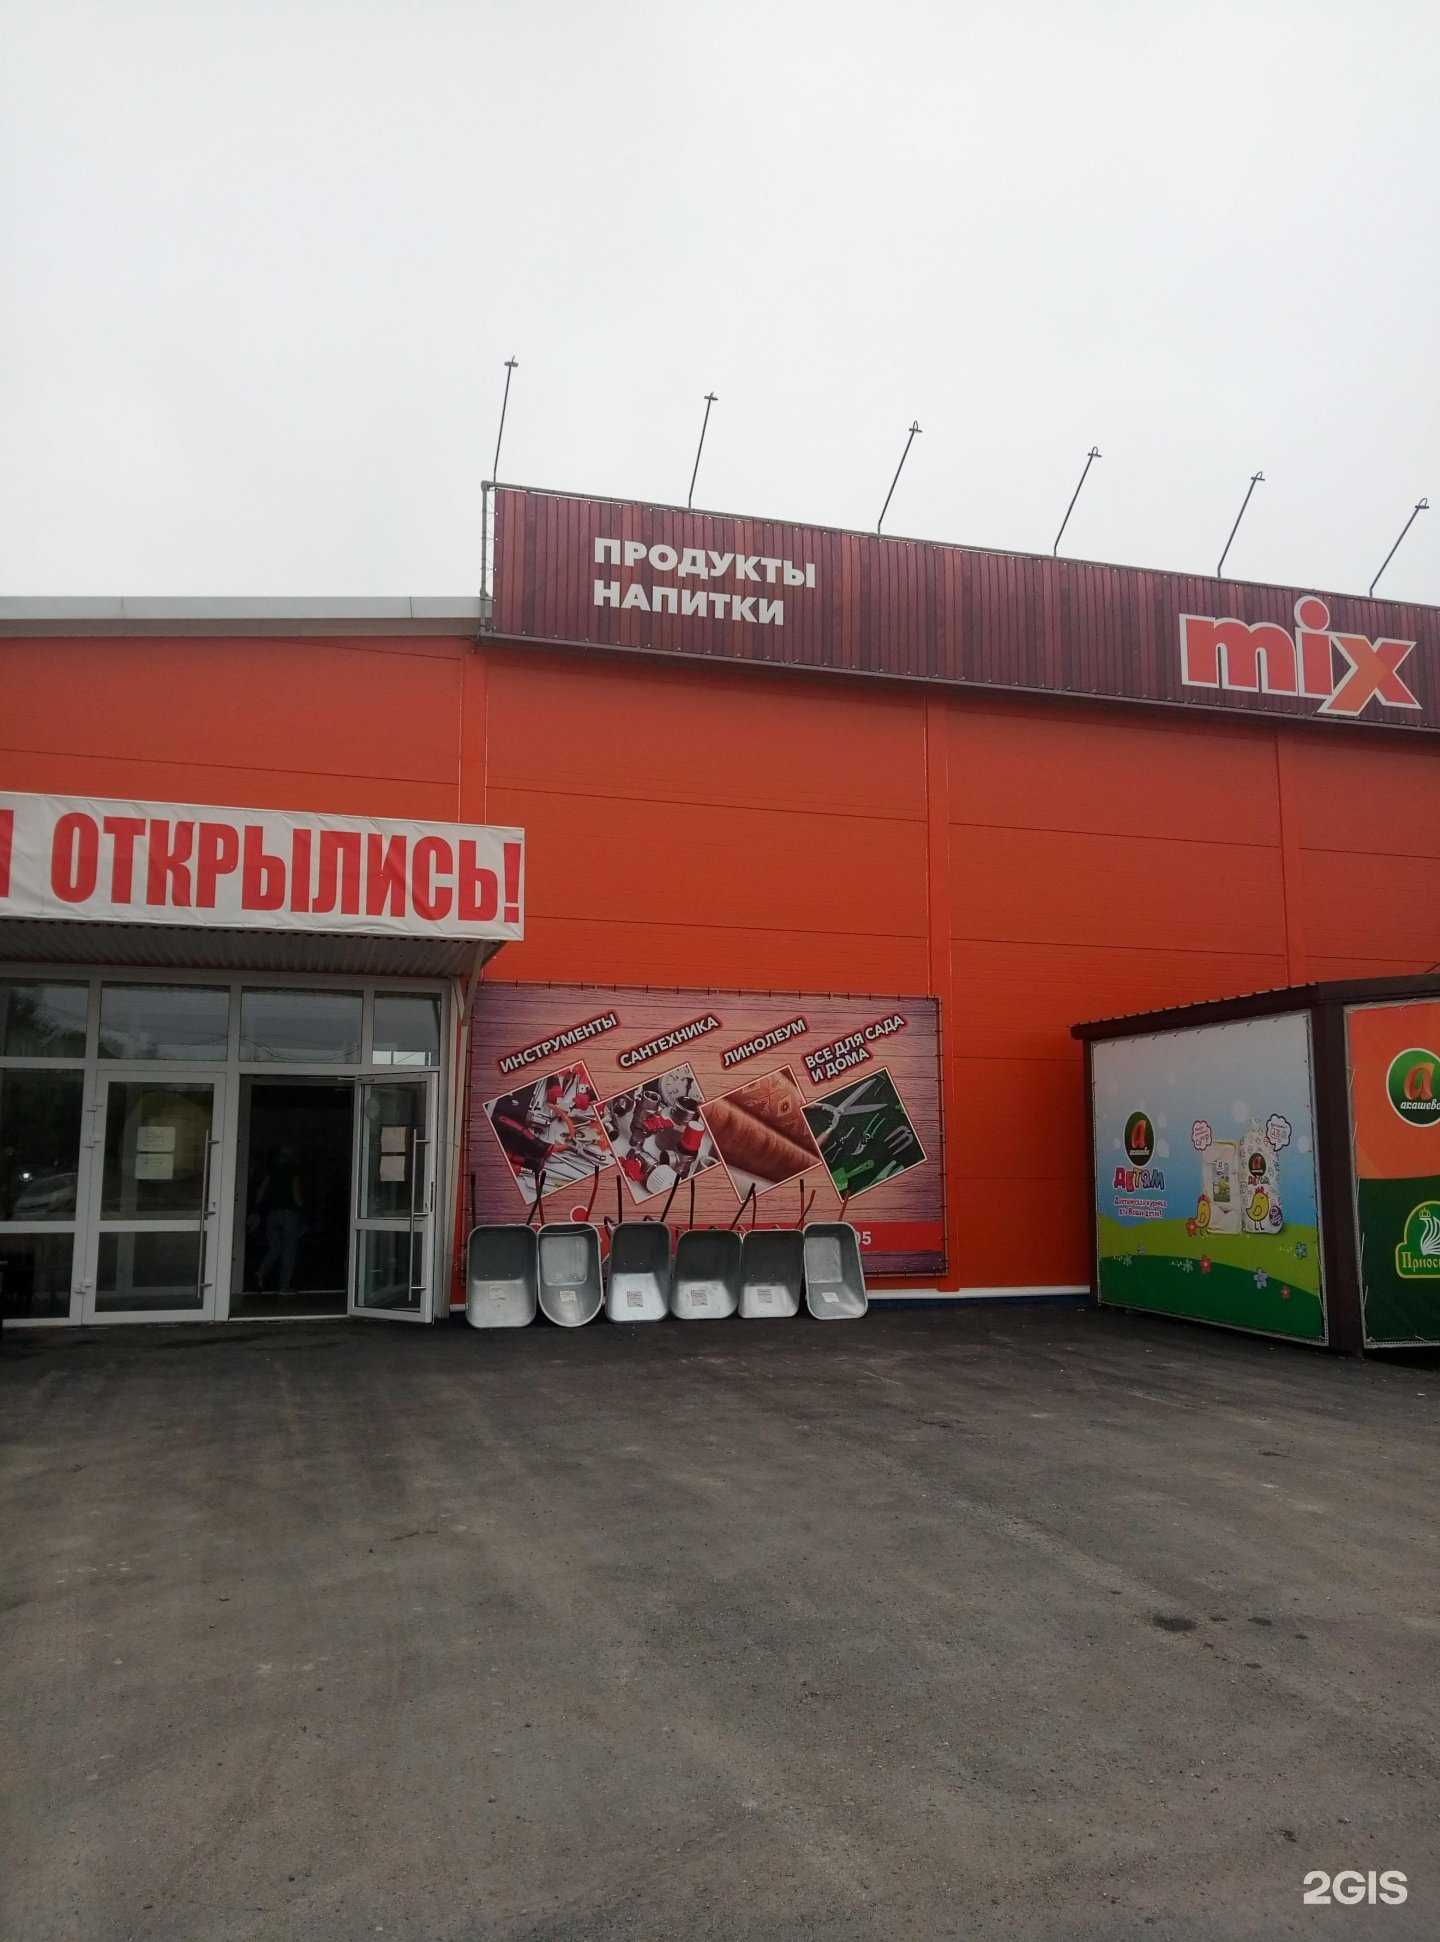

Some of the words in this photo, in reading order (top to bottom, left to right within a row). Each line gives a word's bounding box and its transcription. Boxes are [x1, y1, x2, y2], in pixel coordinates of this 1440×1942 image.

[594, 537, 816, 588] ПРОДУКТЫ
[593, 579, 784, 626] НАПИТКИ
[1178, 596, 1423, 716] mix
[50, 811, 522, 924] ОТКРЫЛИСЬ!
[500, 1013, 618, 1073] ИНСТРУМЕНТЫ
[619, 1016, 720, 1068] САНТЕХНИКА
[723, 1019, 806, 1067] ЛИНОЛЕУМ
[805, 1048, 833, 1069] ВСЕ
[835, 1033, 864, 1055] ДЛЯ
[865, 1015, 904, 1040] САДА
[811, 1068, 824, 1083] И
[825, 1048, 869, 1078] ДОМА
[1400, 1251, 1440, 1273] Приос
